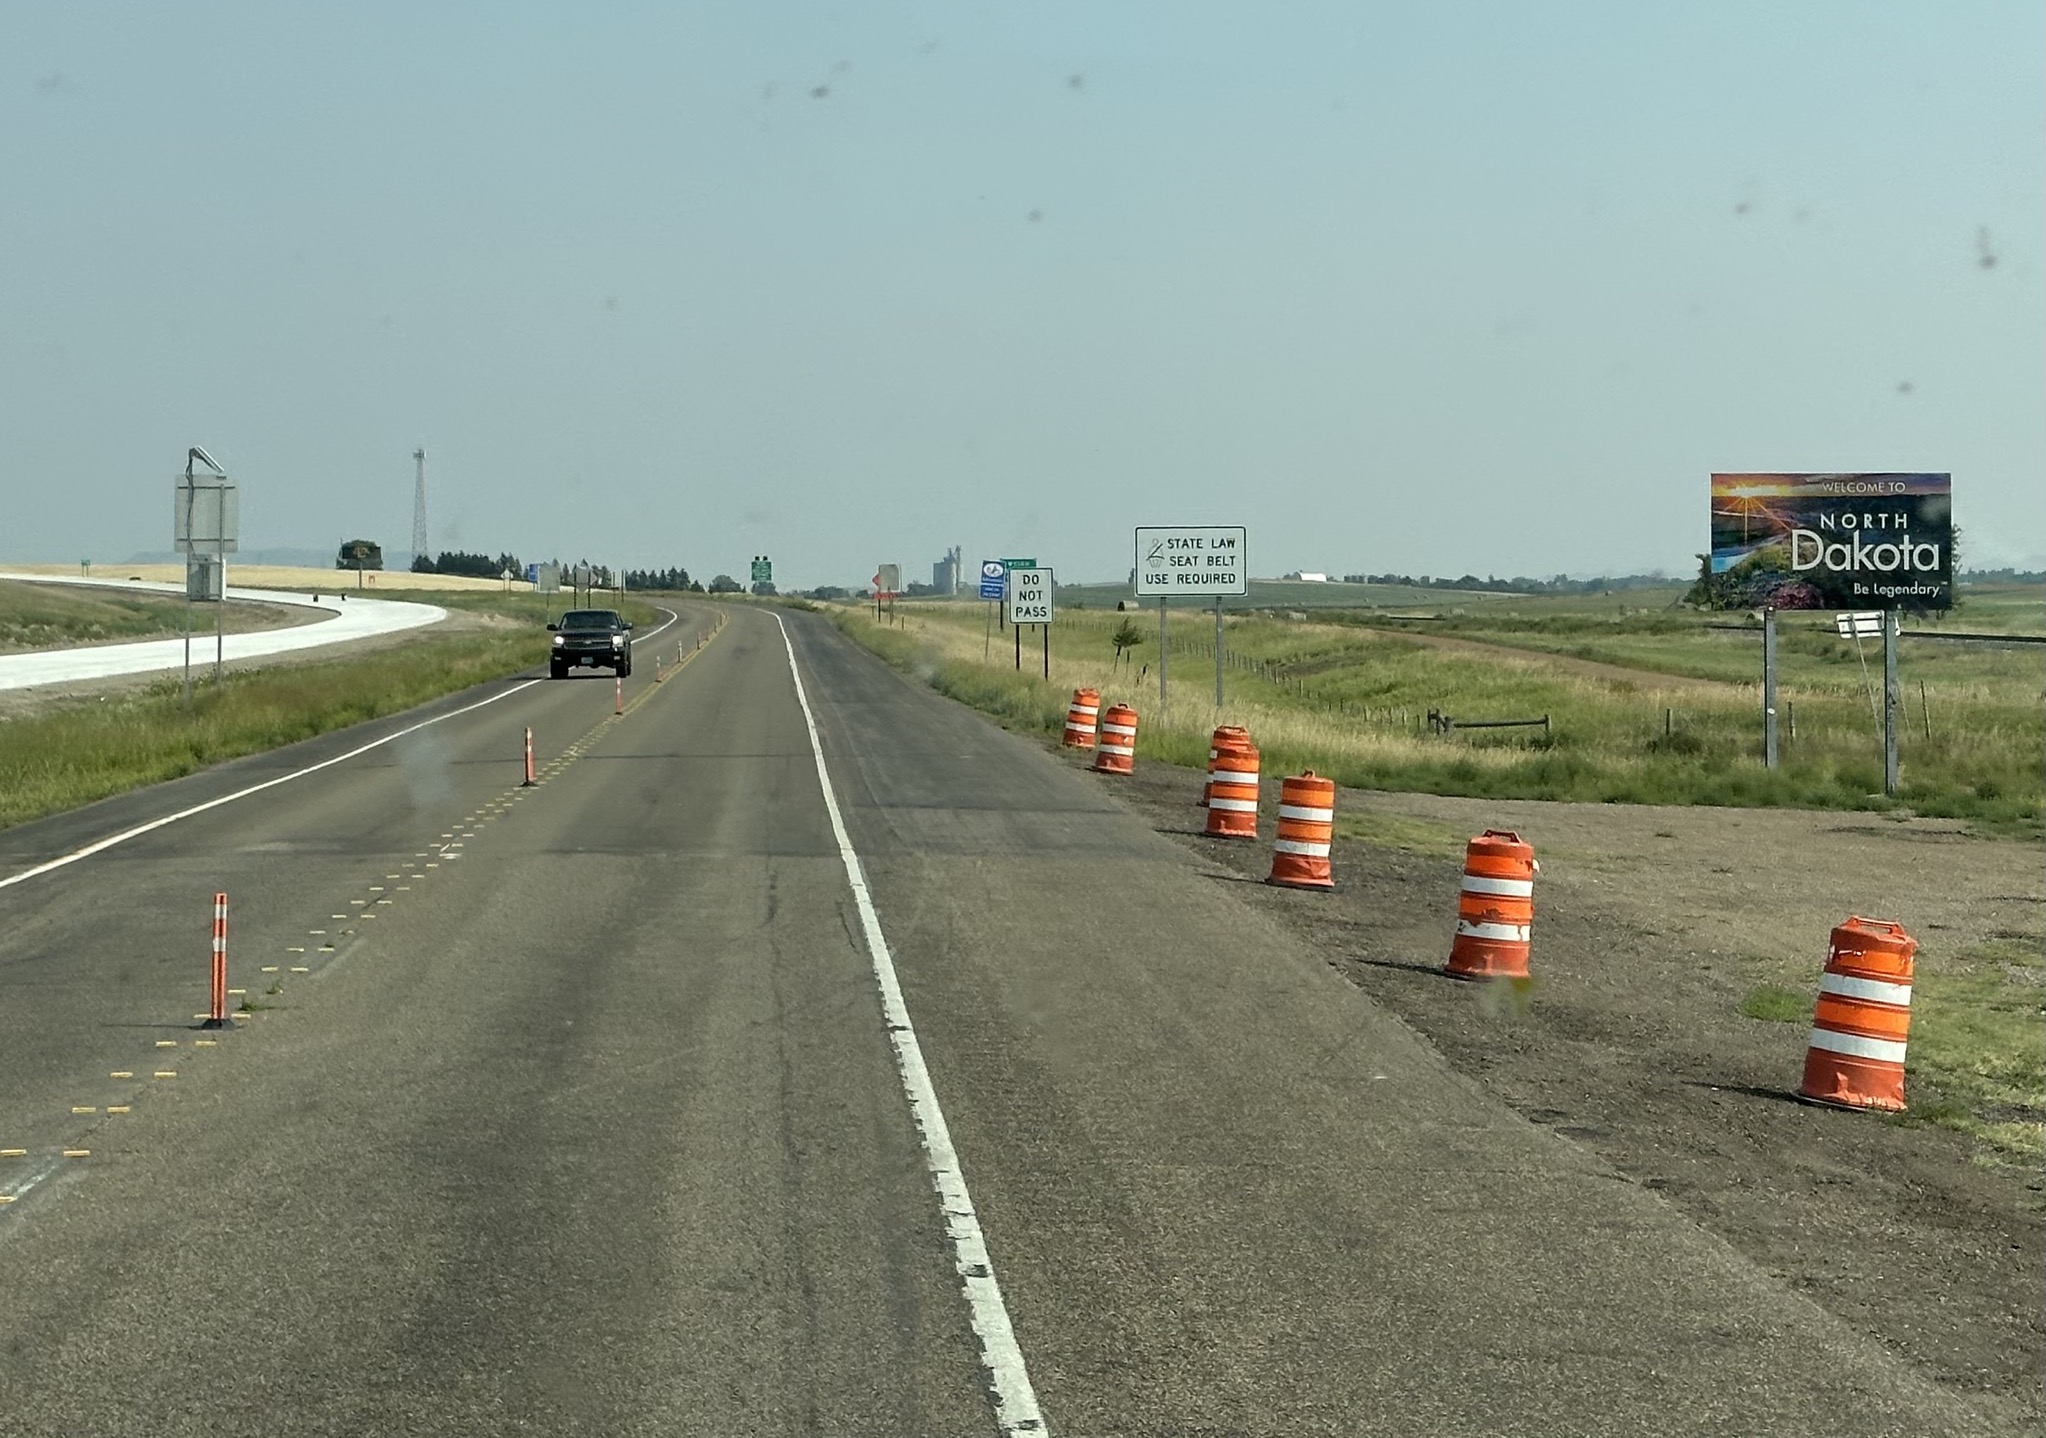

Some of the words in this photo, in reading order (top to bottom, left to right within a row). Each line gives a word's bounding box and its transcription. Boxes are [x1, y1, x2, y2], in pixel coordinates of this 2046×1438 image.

[1822, 482, 1885, 492] WELCOME
[1888, 482, 1905, 492] TO
[1820, 513, 1908, 529] NORTH
[1168, 539, 1203, 548] STATE
[1212, 539, 1235, 548] LAW
[1792, 529, 1940, 571] Dakota
[1170, 556, 1198, 566] SEAT
[1207, 556, 1235, 566] BELT
[1023, 575, 1039, 585] DO
[1146, 574, 1168, 584] USE
[1177, 574, 1235, 584] REQUIRED
[1854, 582, 1869, 595] Be
[1019, 591, 1042, 601] NOT
[1016, 606, 1047, 617] PASS
